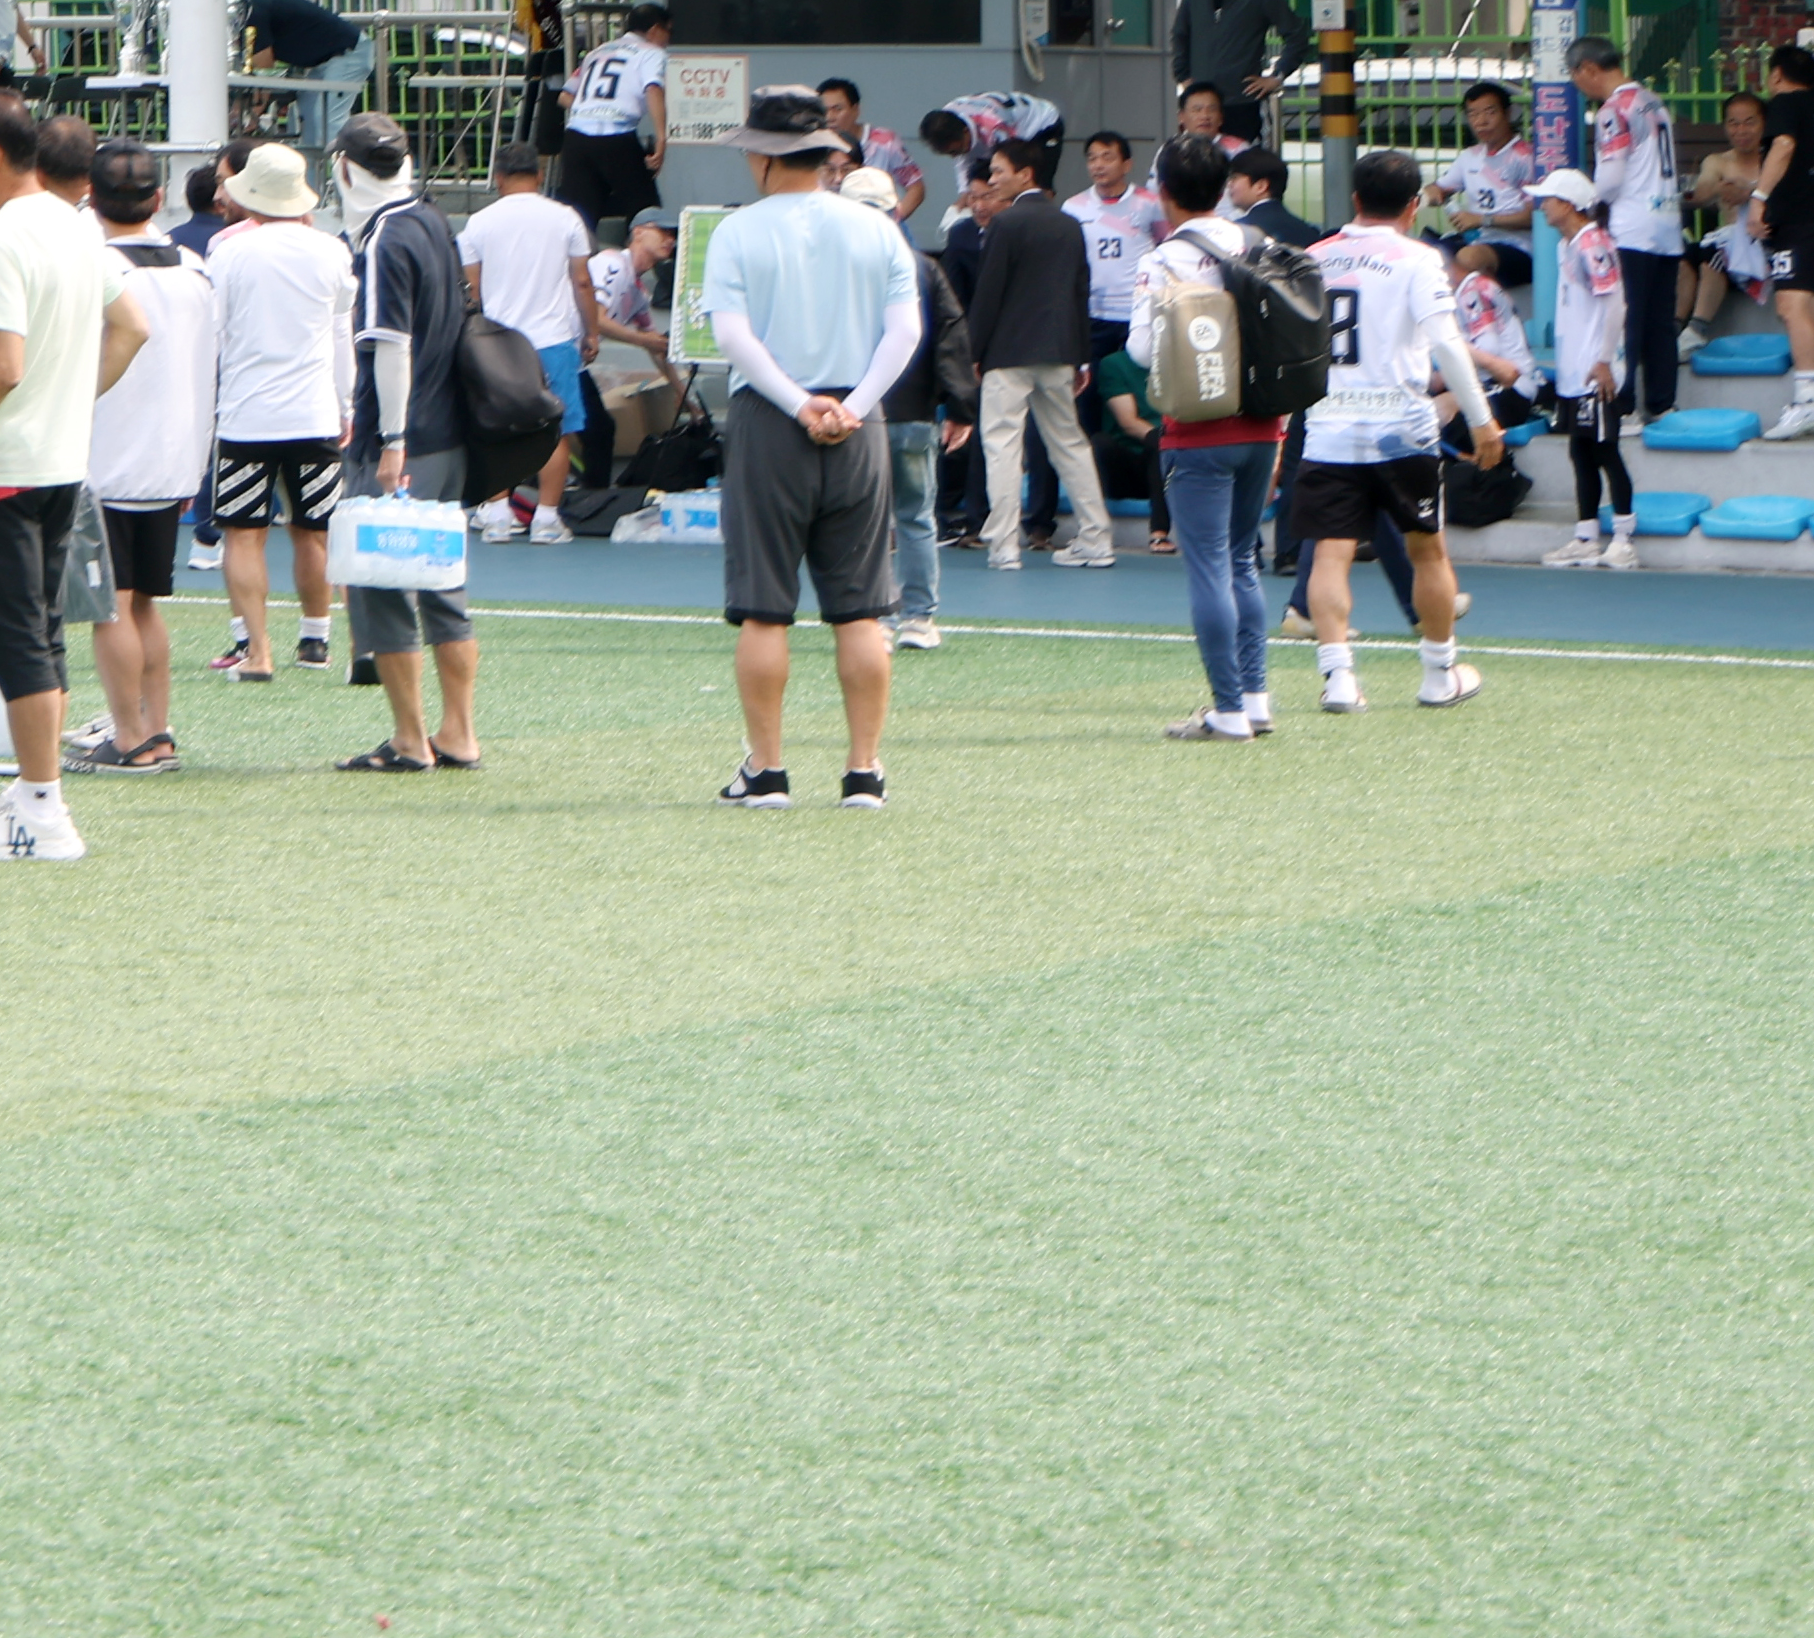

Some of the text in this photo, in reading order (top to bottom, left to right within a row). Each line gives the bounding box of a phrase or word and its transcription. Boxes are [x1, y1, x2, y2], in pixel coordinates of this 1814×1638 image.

[581, 58, 627, 102] 15
[680, 68, 731, 84] CCTV
[1535, 86, 1571, 176] 도난주
[1097, 238, 1122, 259] 23
[6, 815, 36, 856] LA
